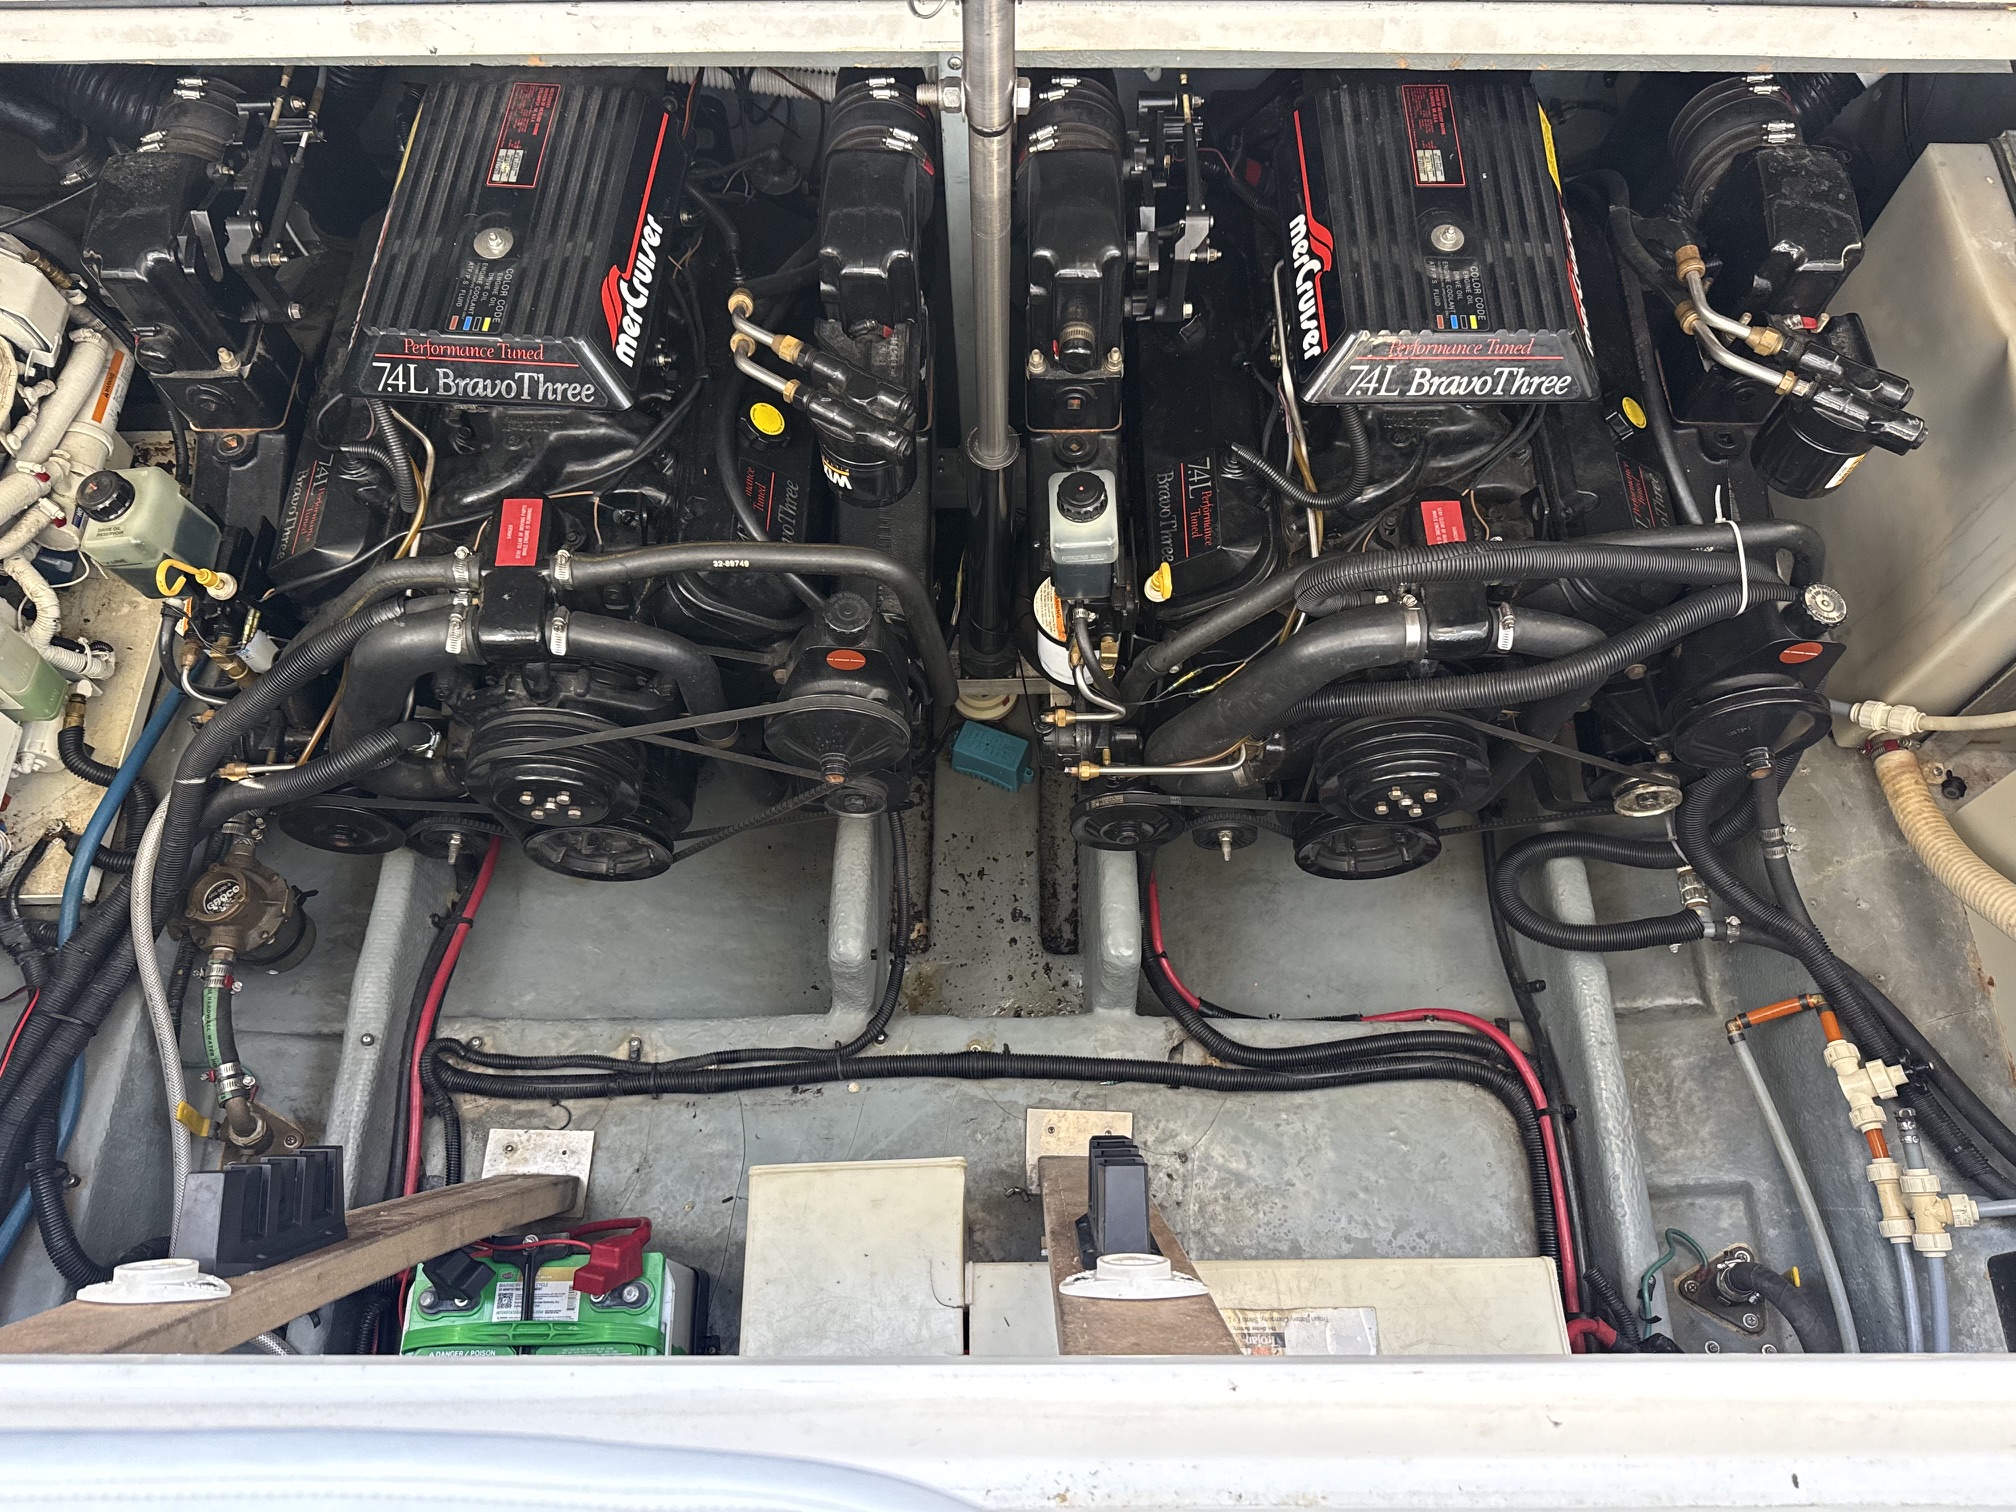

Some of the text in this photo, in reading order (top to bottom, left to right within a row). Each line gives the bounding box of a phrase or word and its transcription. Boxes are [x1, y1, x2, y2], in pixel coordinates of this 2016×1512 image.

[468, 263, 488, 315] ENGINE COOLANT
[484, 273, 494, 289] DRIVE
[492, 273, 503, 296] ENGINE
[1442, 261, 1455, 313] ENGINE COOLANT
[1453, 271, 1461, 288] DRIVE
[1463, 271, 1471, 293] ENGINE
[1470, 266, 1486, 320] COLOR CODE
[456, 290, 466, 307] FLUID
[493, 268, 514, 323] COLOR CODE
[404, 338, 544, 360] Performance Tuned
[1388, 338, 1535, 356] Performance Tuned
[372, 361, 596, 403] 7.4L BravoThree
[1345, 364, 1572, 397] 7.4L BravoThree
[753, 481, 767, 512] Tuned
[277, 467, 308, 559] BravoThree
[301, 508, 312, 534] Tuned
[306, 487, 325, 543] Performance
[1157, 470, 1177, 562] BravoThree
[1190, 509, 1202, 539] Tuned
[1200, 490, 1215, 547] Performance
[207, 885, 239, 910] GROCO
[1245, 1334, 1276, 1348] Trojan
